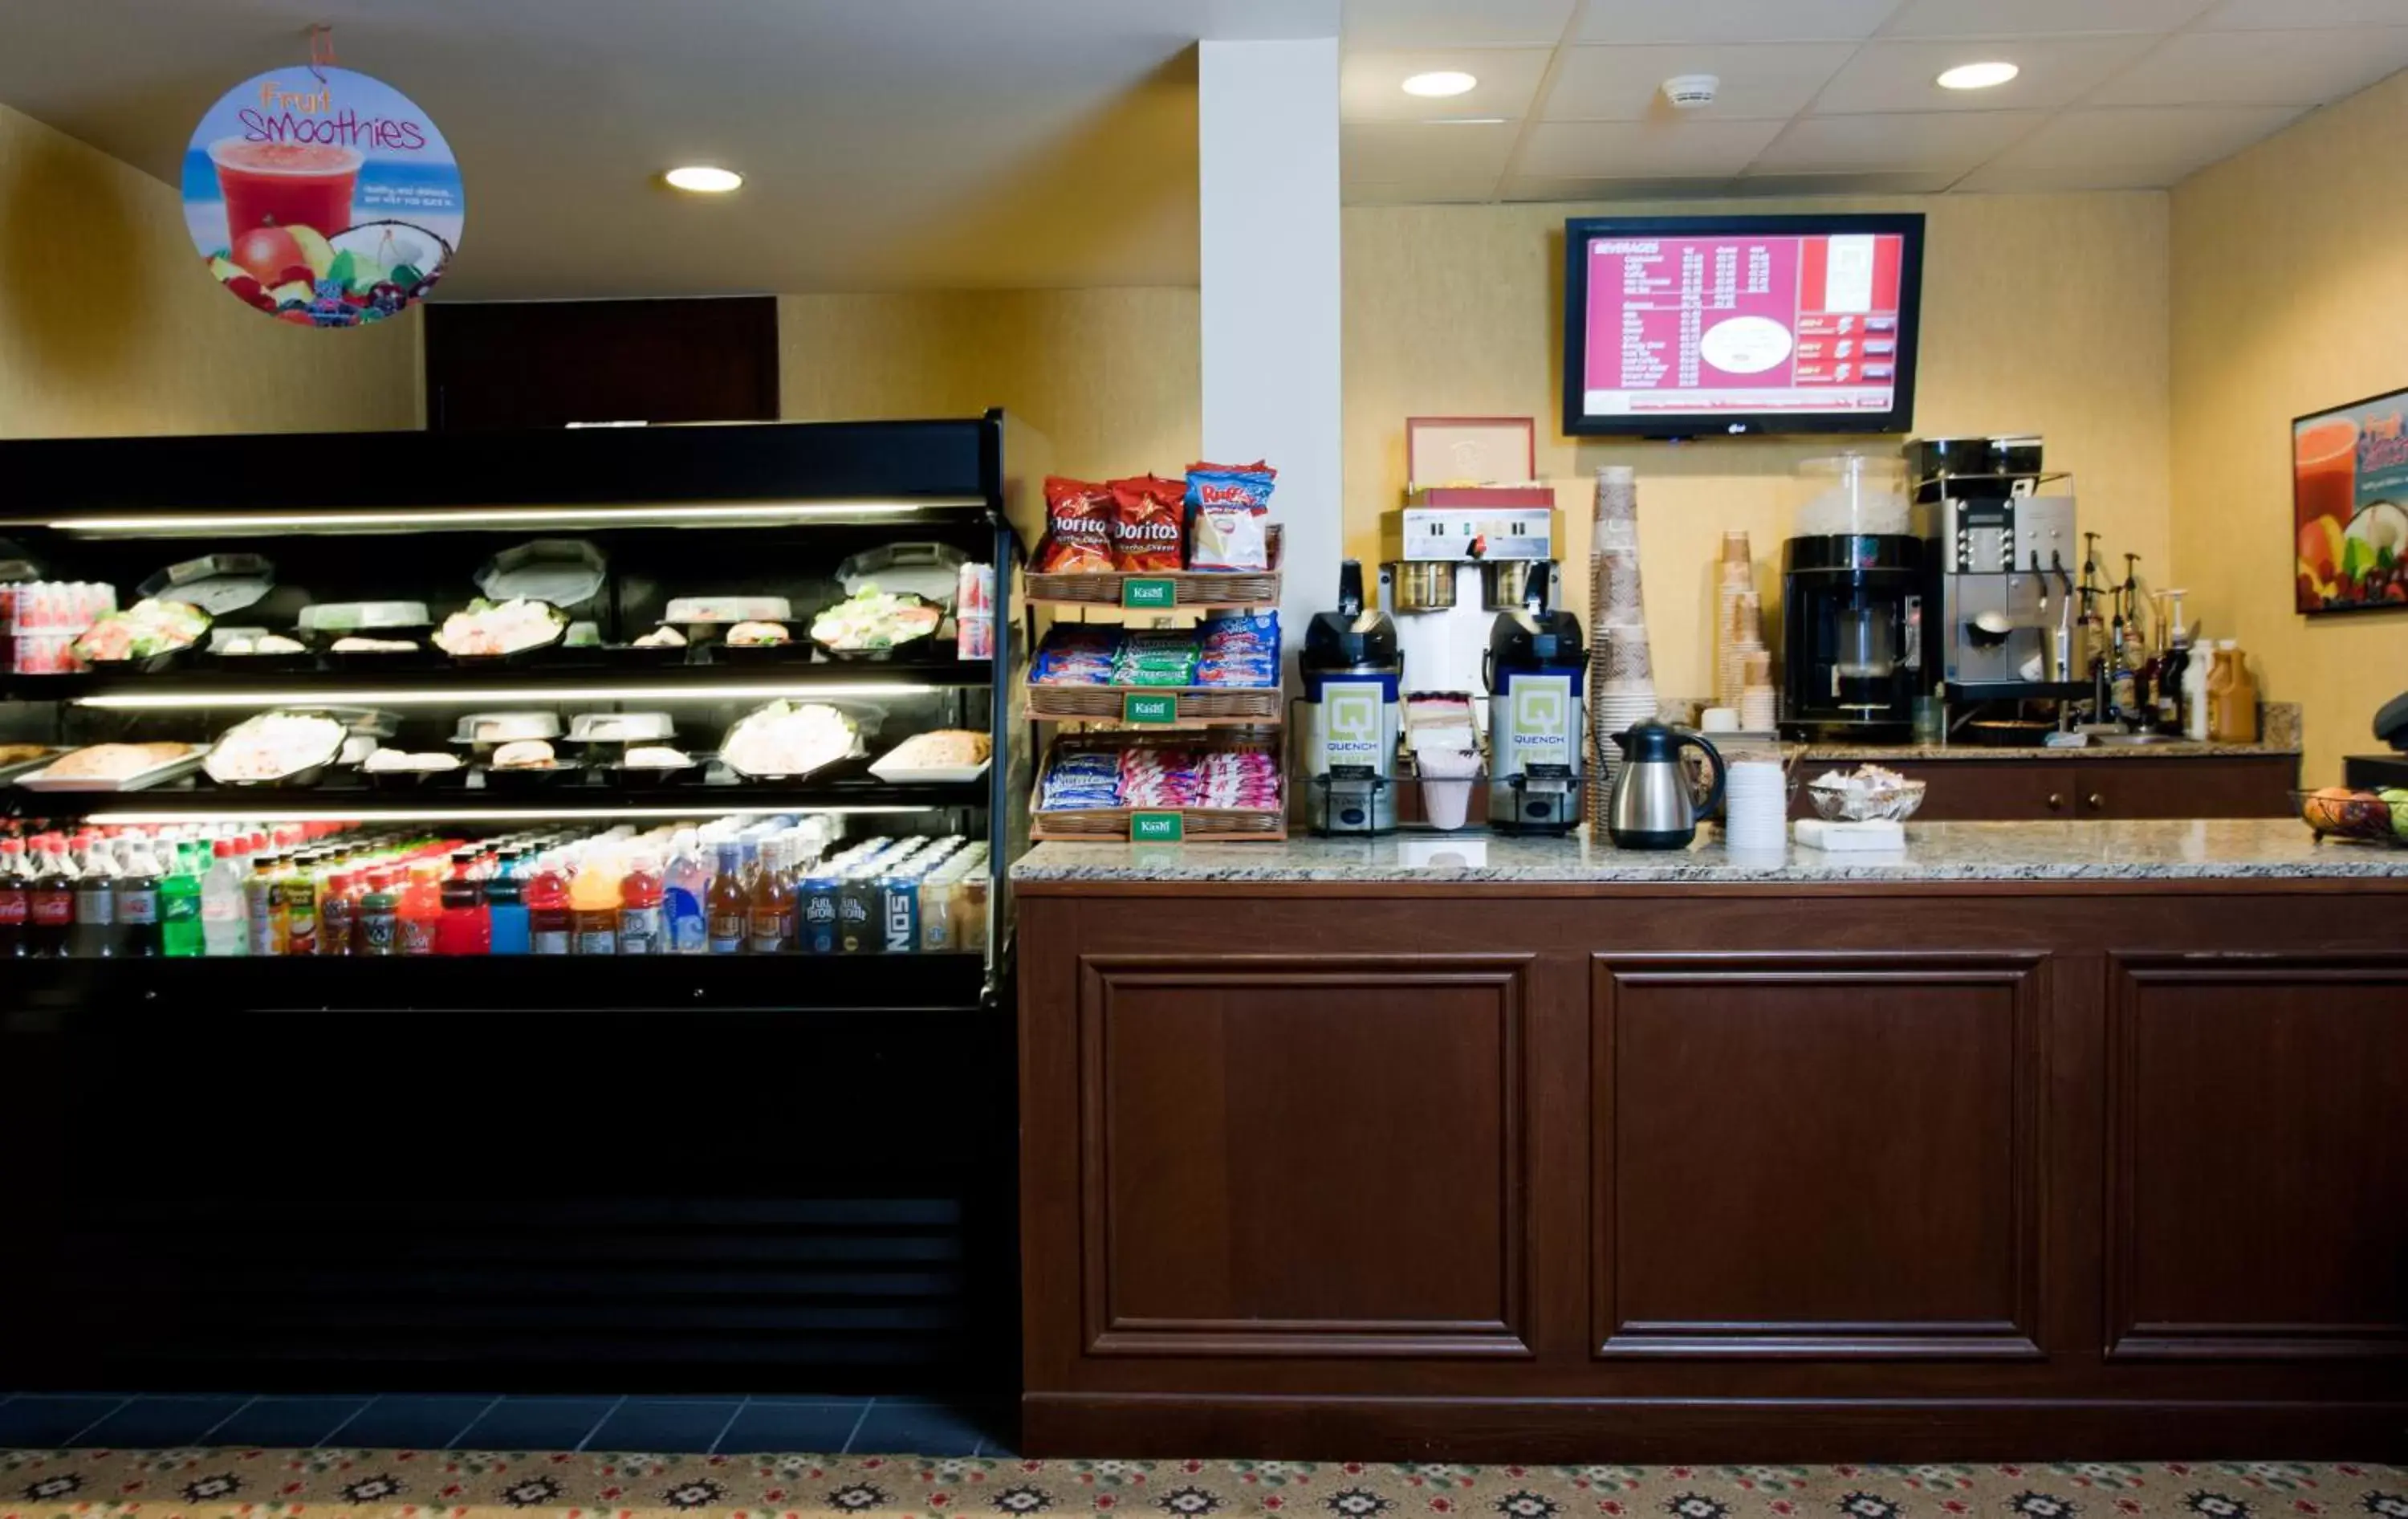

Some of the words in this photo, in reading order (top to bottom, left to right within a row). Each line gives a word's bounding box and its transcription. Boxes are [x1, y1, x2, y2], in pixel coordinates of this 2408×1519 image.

[258, 82, 331, 113] Fruit
[1514, 734, 1565, 745] QUENCH
[1326, 742, 1377, 751] QUENCH
